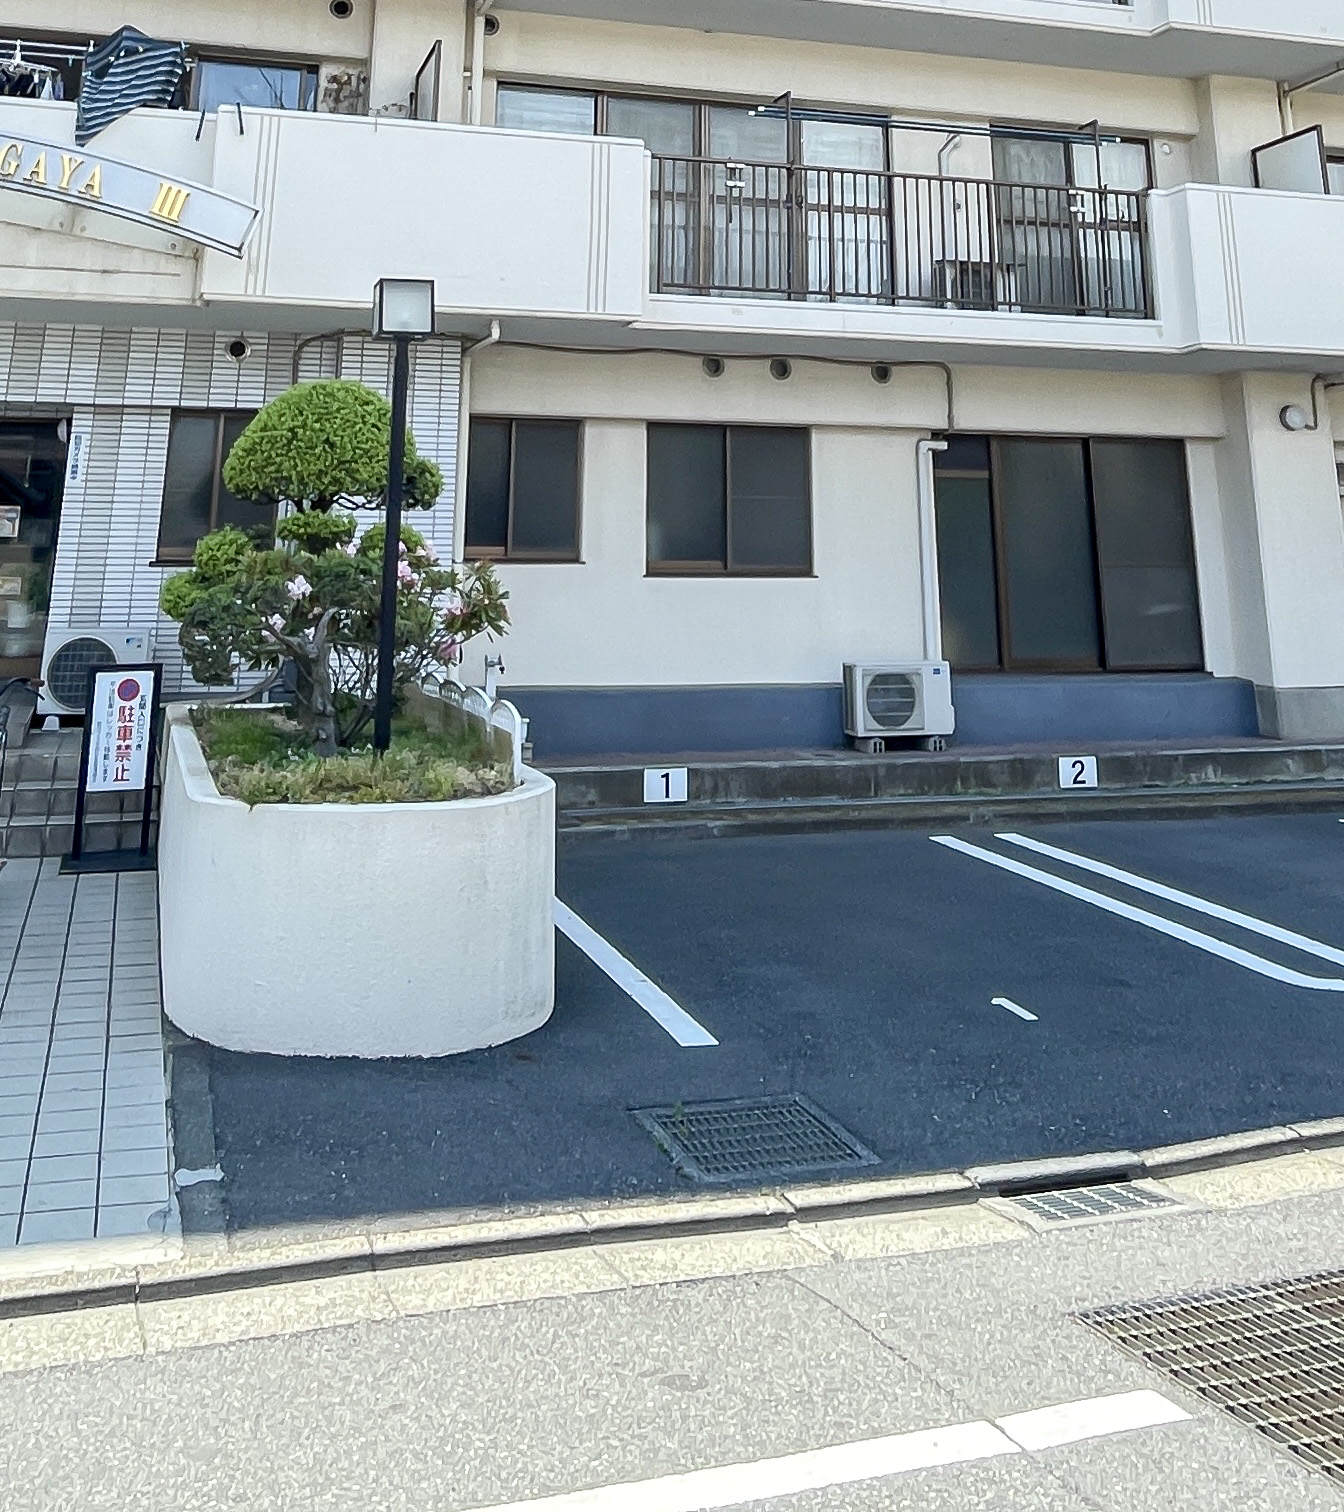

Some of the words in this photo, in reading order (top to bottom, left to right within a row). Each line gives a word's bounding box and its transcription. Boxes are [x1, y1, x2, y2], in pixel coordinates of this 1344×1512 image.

[112, 705, 137, 783] 駐車禁止
[660, 772, 671, 799] 1
[1071, 759, 1087, 785] 2
